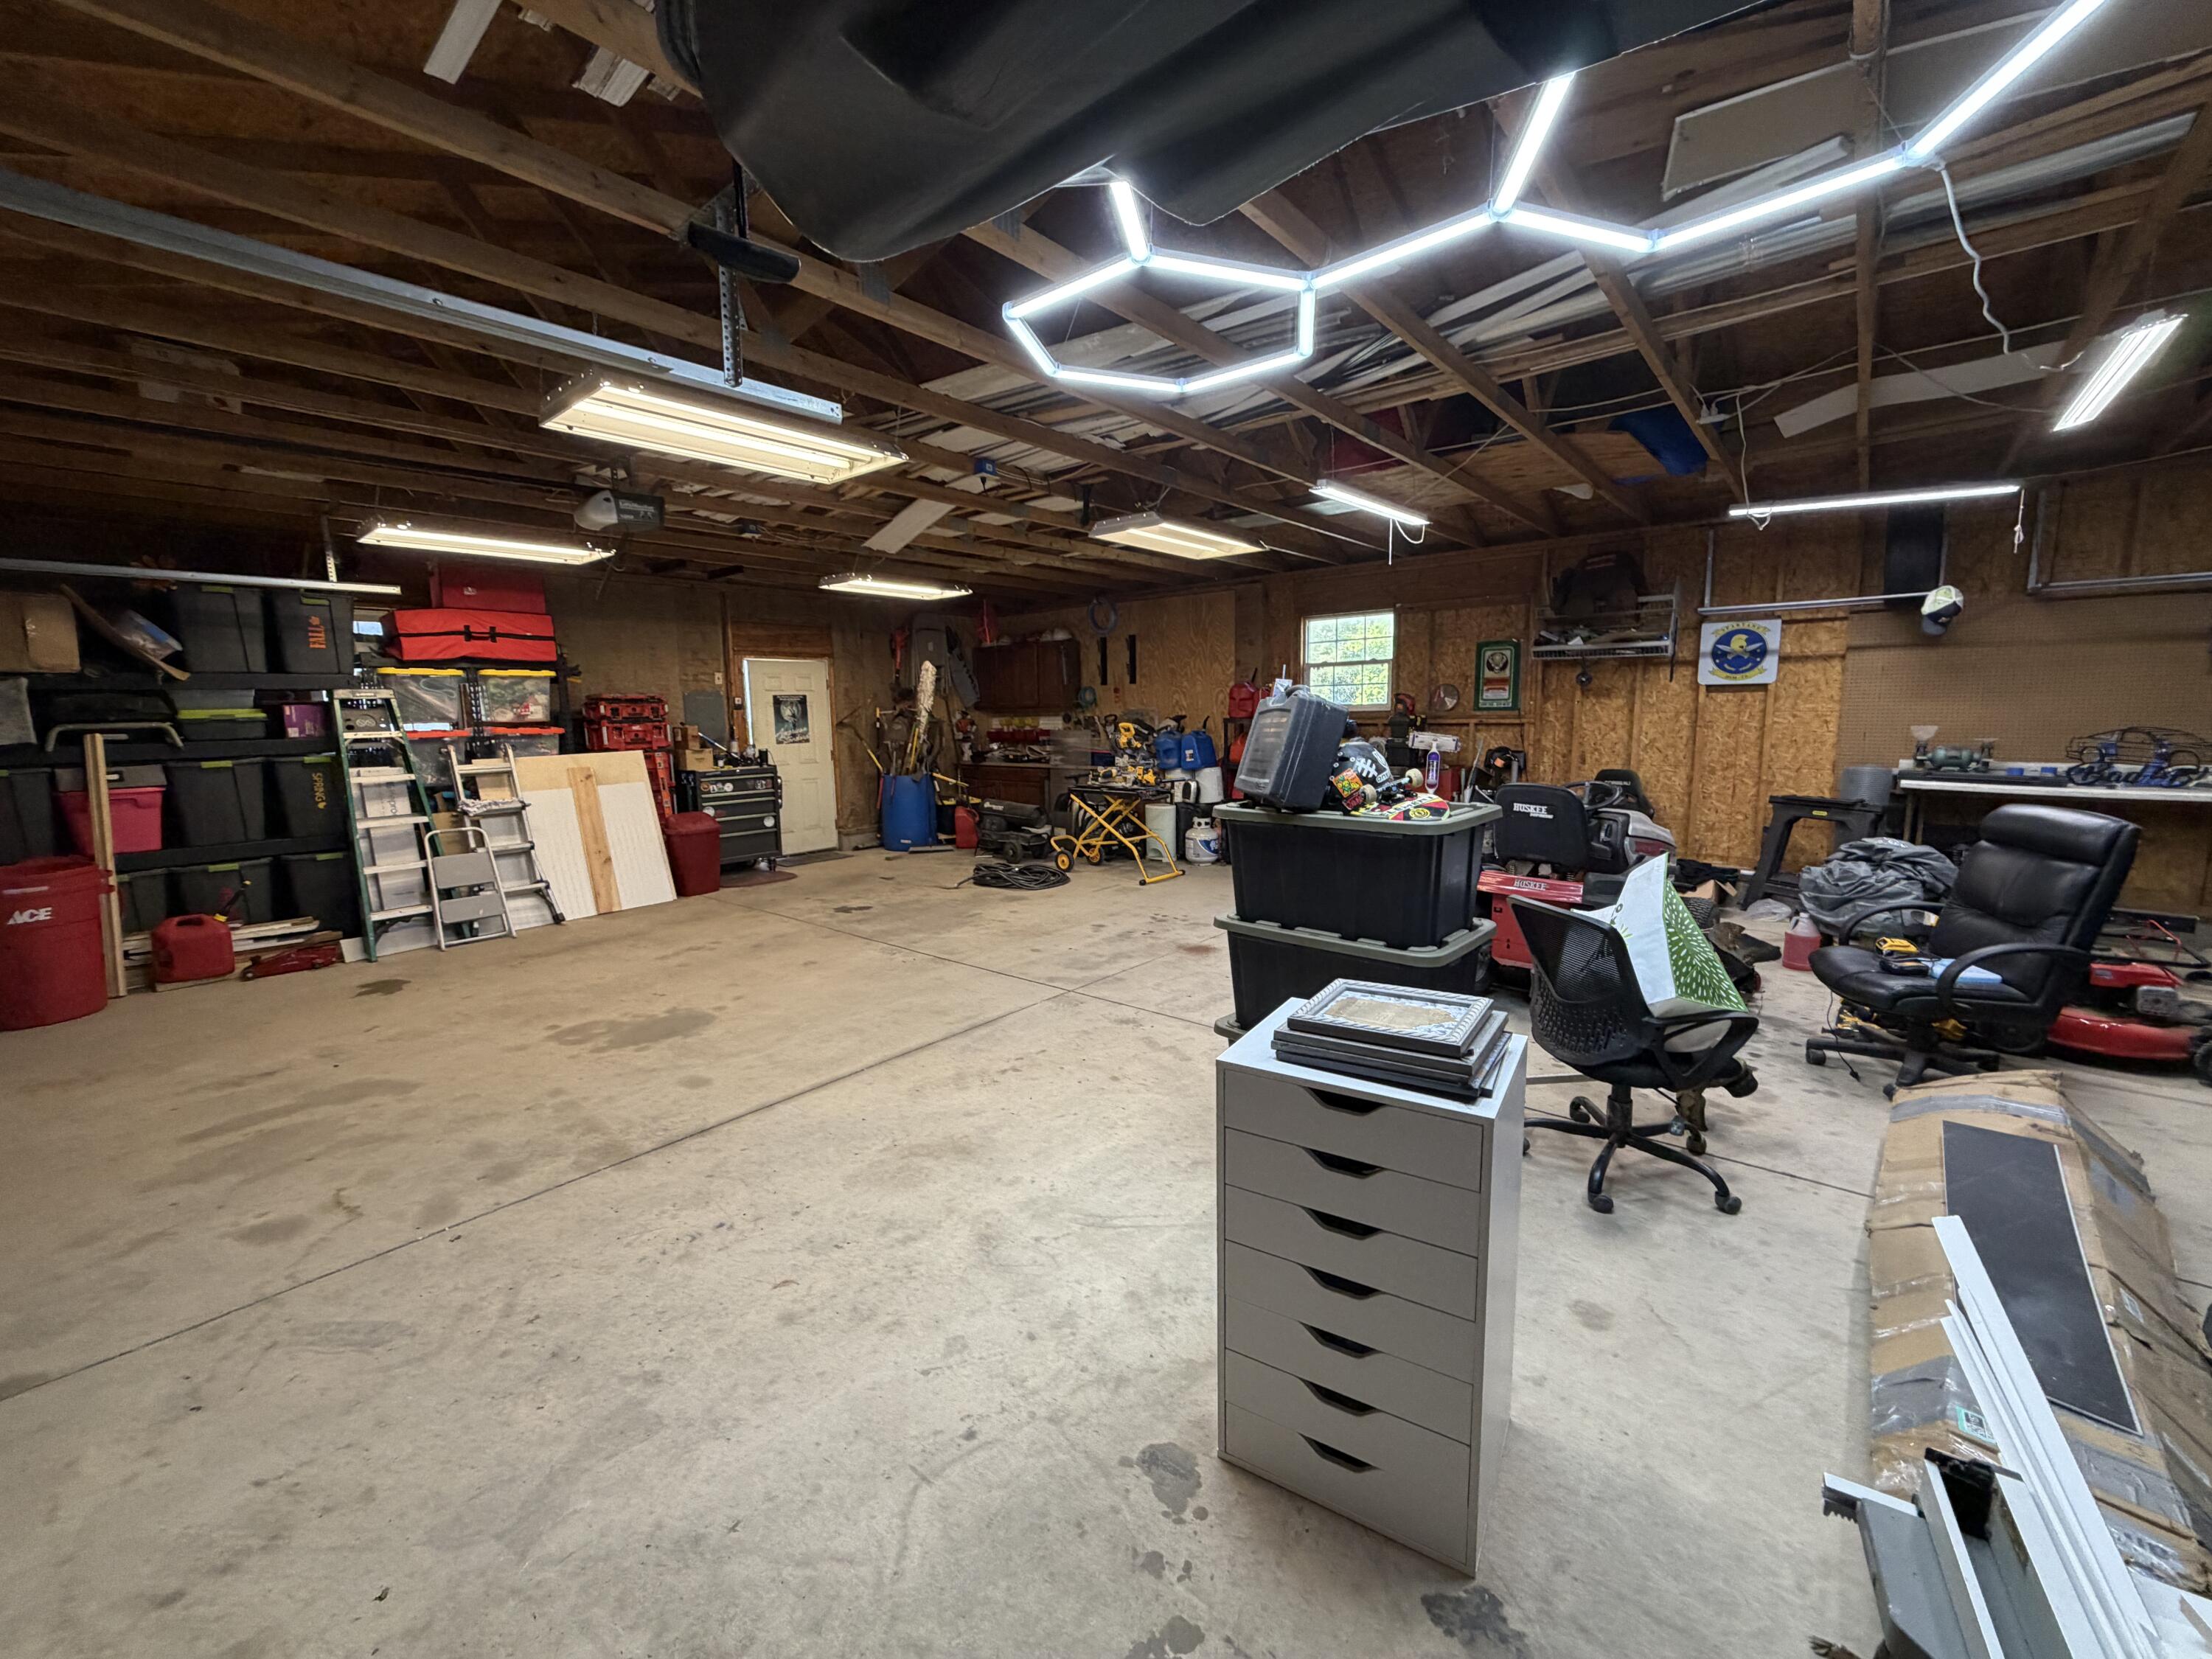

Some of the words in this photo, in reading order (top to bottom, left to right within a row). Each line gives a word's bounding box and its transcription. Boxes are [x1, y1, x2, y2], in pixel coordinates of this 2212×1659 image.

[312, 772, 326, 802] SPRING
[1513, 802, 1548, 815] HUSKEE
[1514, 878, 1547, 891] HUSKEE
[7, 907, 54, 925] ACE
